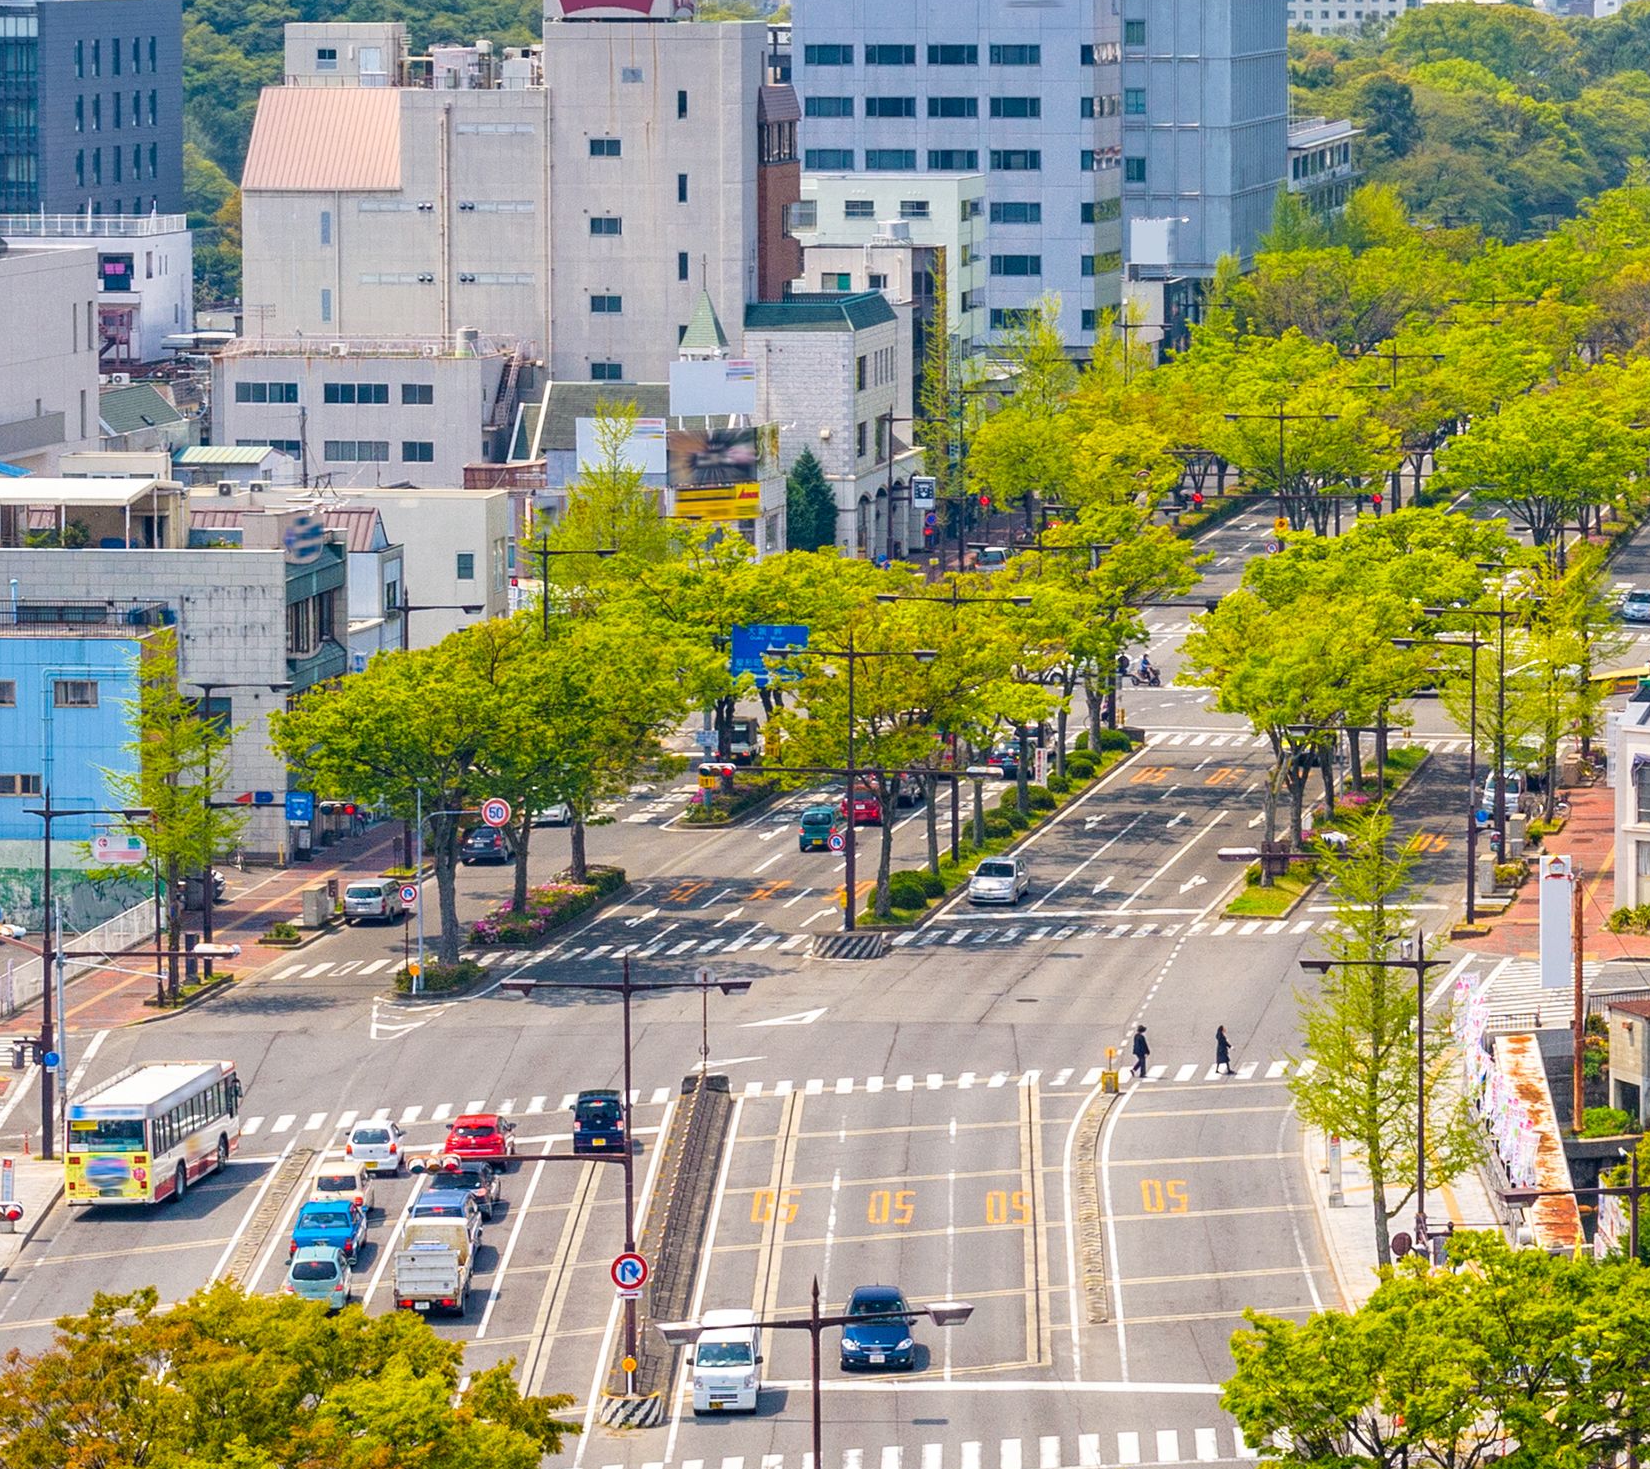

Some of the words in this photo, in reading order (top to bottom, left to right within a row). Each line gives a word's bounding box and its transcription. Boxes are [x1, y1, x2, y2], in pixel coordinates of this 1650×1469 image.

[488, 806, 504, 819] 50
[868, 1190, 916, 1224] 50
[986, 1191, 1031, 1224] 50
[1140, 1179, 1188, 1213] 50
